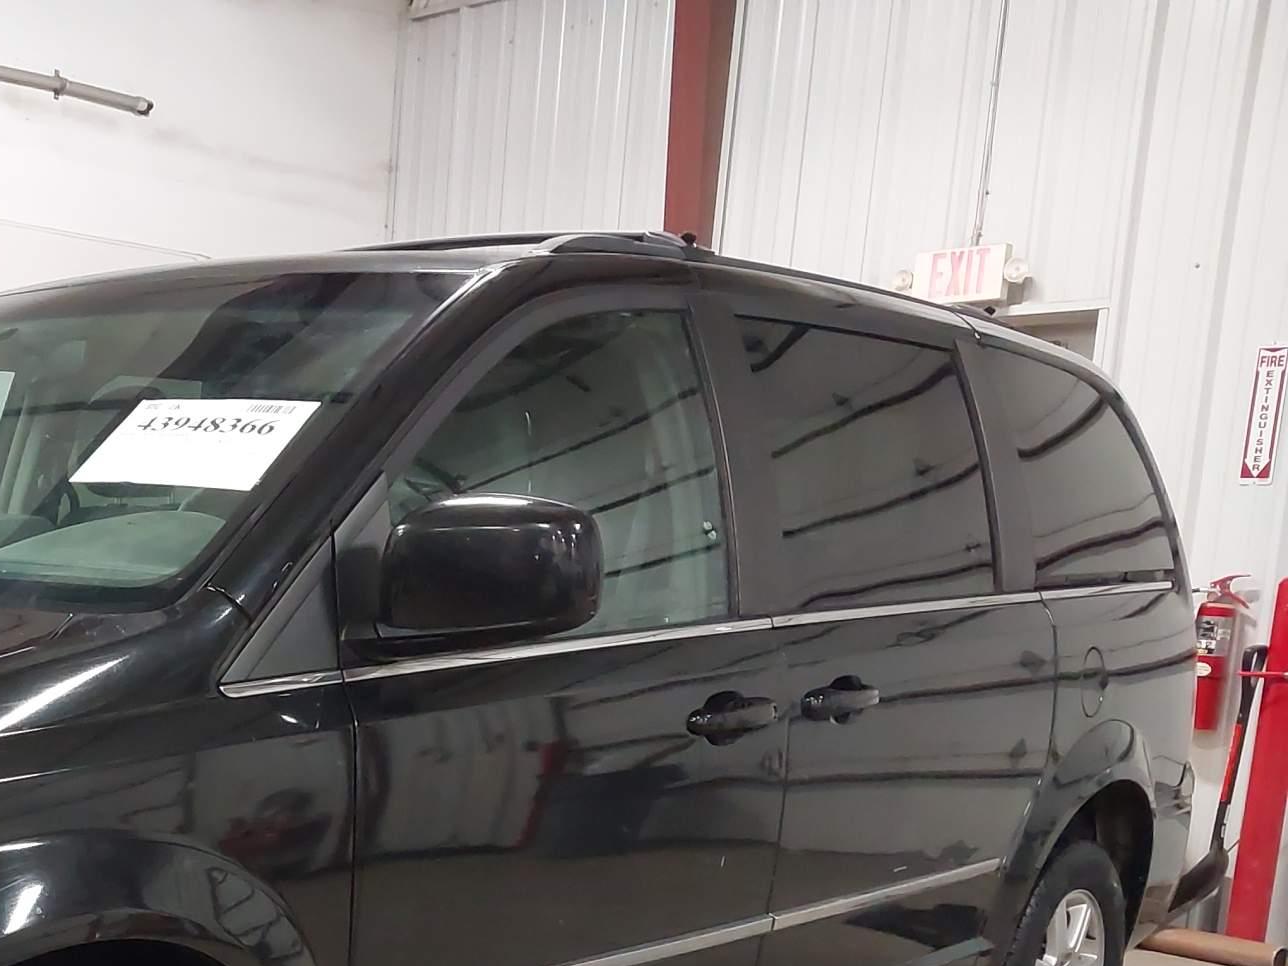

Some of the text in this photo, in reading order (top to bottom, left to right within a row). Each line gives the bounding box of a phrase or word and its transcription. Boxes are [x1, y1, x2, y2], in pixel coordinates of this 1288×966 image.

[928, 248, 990, 298] EXIT
[1259, 355, 1285, 367] FIRE
[137, 416, 280, 436] 43948366
[1252, 370, 1274, 471] EXTINGUISHER
